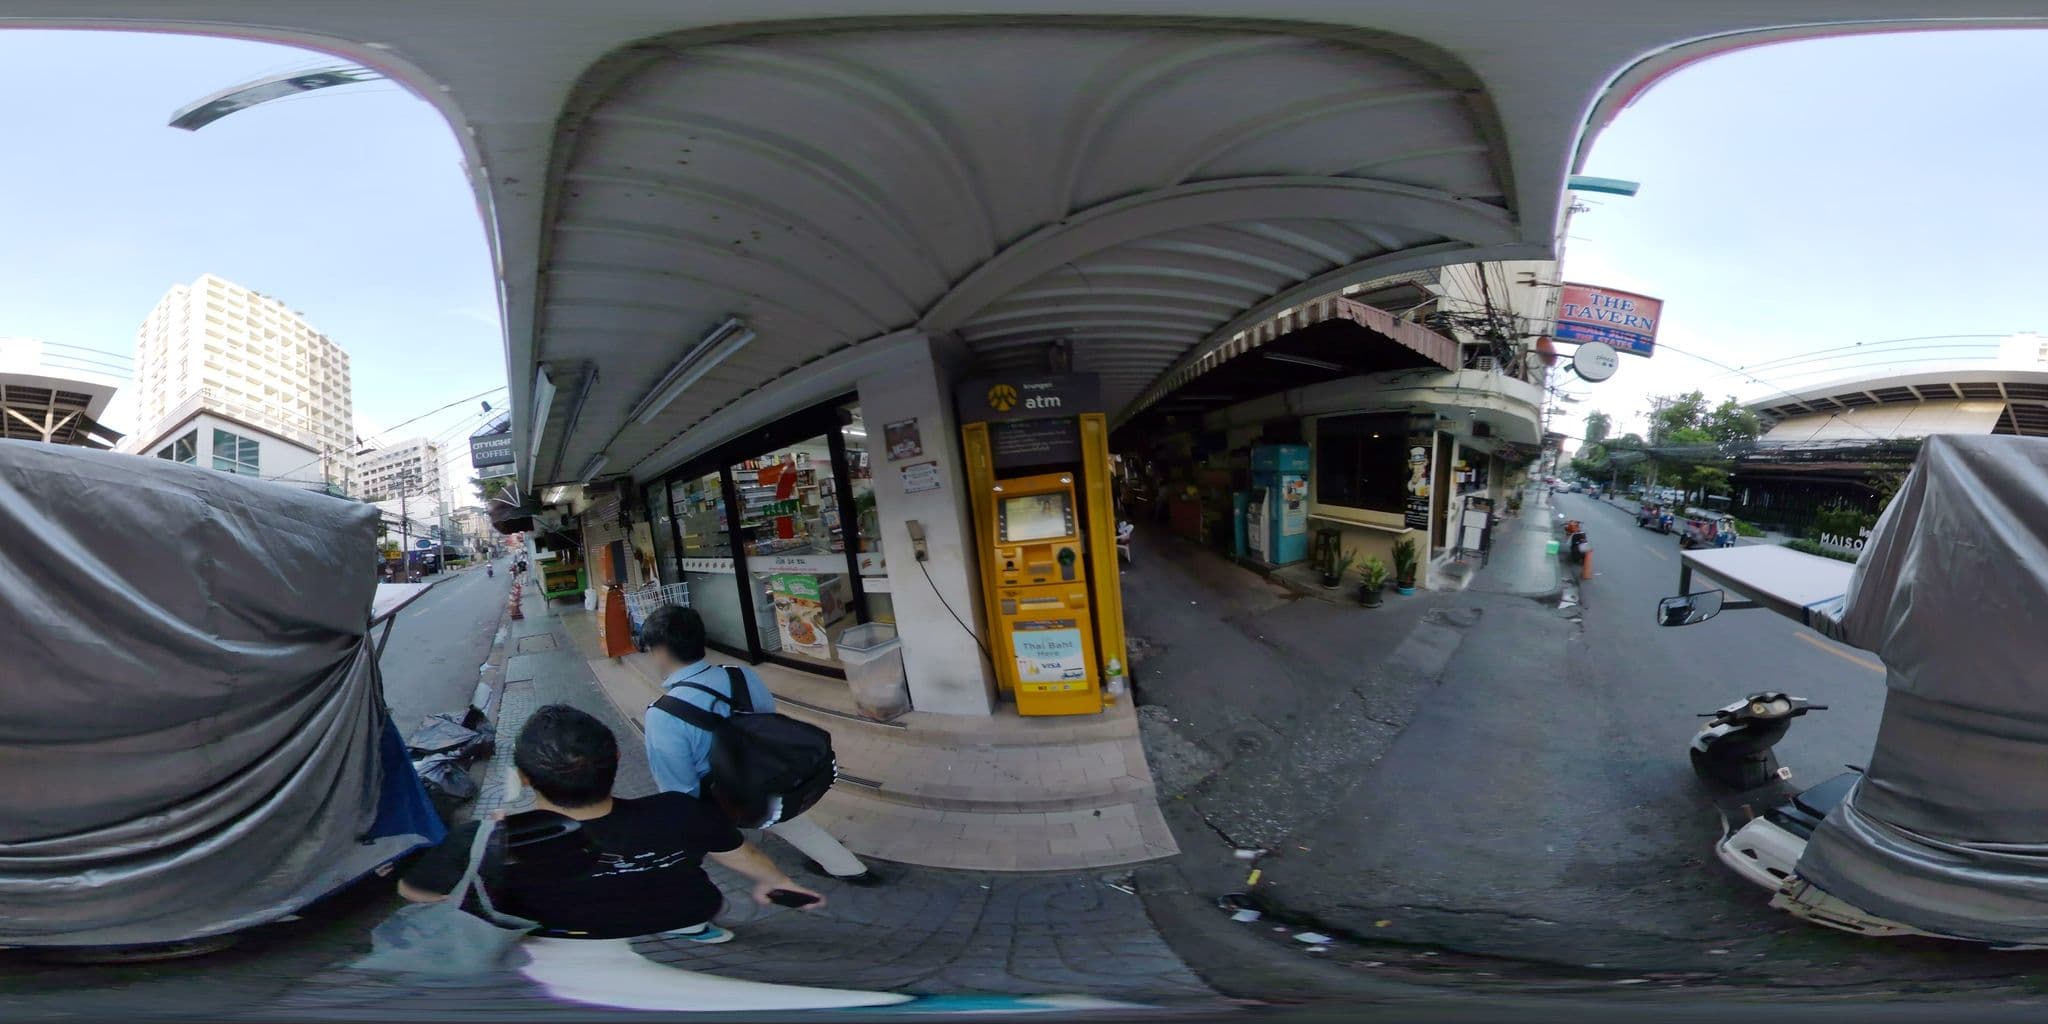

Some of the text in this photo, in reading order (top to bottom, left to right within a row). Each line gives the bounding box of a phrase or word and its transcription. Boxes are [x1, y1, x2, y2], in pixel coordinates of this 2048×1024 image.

[1590, 293, 1634, 312] THE
[1564, 303, 1653, 332] TAVERN
[1025, 395, 1061, 409] atm
[475, 449, 511, 459] COFFEE
